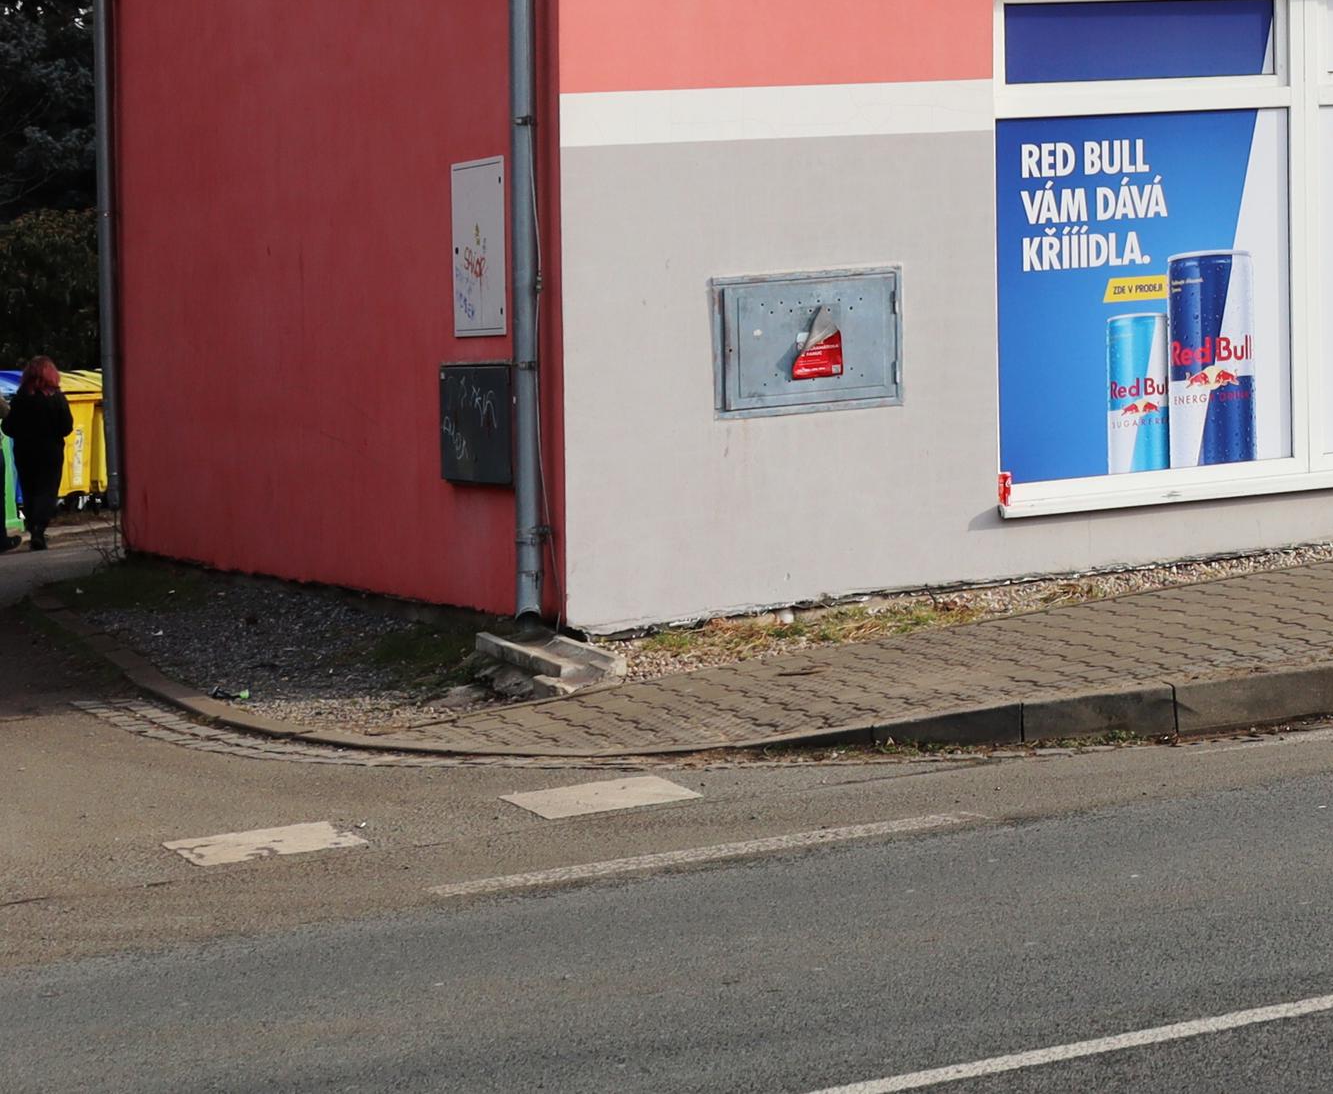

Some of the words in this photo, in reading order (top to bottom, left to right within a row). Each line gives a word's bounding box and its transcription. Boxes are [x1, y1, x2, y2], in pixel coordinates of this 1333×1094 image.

[1021, 142, 1076, 178] RED
[1084, 139, 1149, 175] BULL
[1020, 180, 1088, 224] VÁM
[1096, 175, 1168, 221] DÁVÁ
[1022, 225, 1151, 272] KŘÍÍÍDLA.
[1113, 285, 1126, 295] ZDE
[1127, 285, 1133, 294] V
[1171, 336, 1212, 367] Red
[1216, 335, 1252, 362] Bull
[1110, 378, 1140, 400] Red
